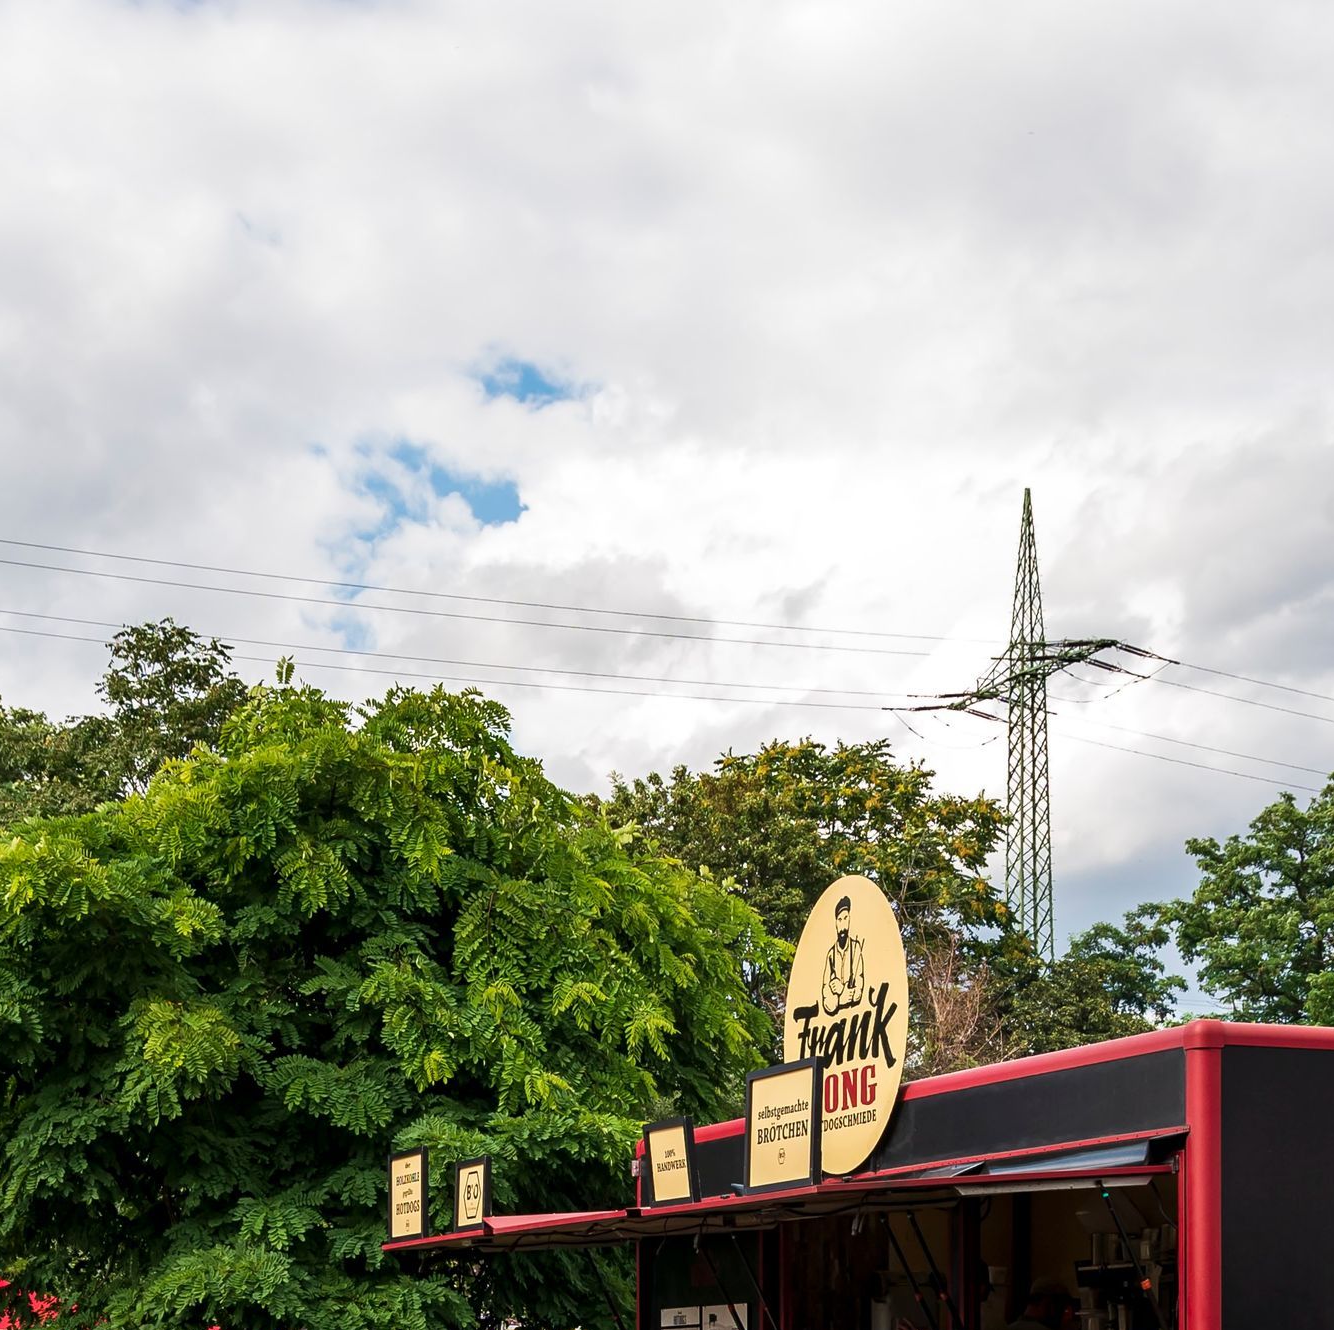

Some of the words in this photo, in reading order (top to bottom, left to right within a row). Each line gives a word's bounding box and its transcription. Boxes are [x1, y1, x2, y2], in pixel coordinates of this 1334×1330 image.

[793, 982, 897, 1070] Frank
[824, 1064, 877, 1114] ONG
[757, 1099, 809, 1121] selbstgemachte
[822, 1109, 877, 1133] DOGSCHMIEDE
[757, 1119, 809, 1145] BRÖTCHEN
[664, 1148, 676, 1158] 100%
[657, 1158, 686, 1173] HANDWERK
[396, 1200, 420, 1215] HOTDOGS
